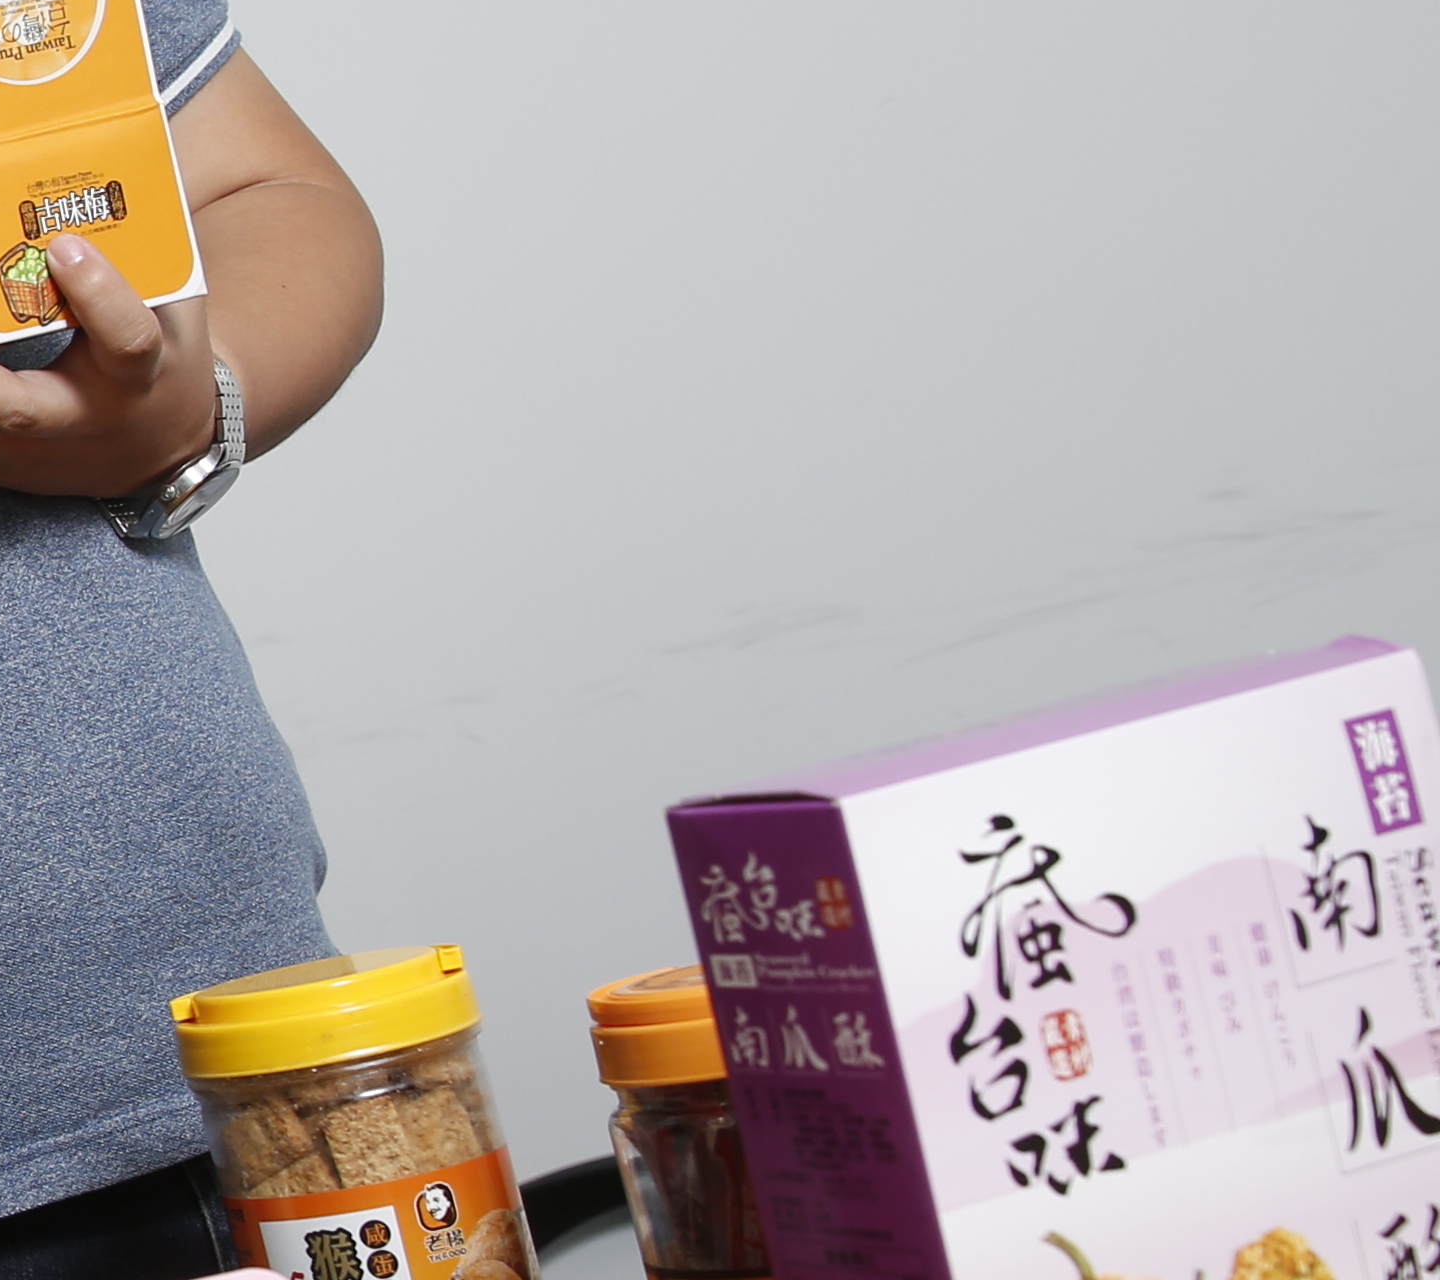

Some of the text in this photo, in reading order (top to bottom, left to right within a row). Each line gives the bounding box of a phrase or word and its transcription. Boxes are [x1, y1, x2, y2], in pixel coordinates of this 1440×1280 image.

[26, 35, 76, 54] Taiwan
[35, 186, 110, 234] 古味梅
